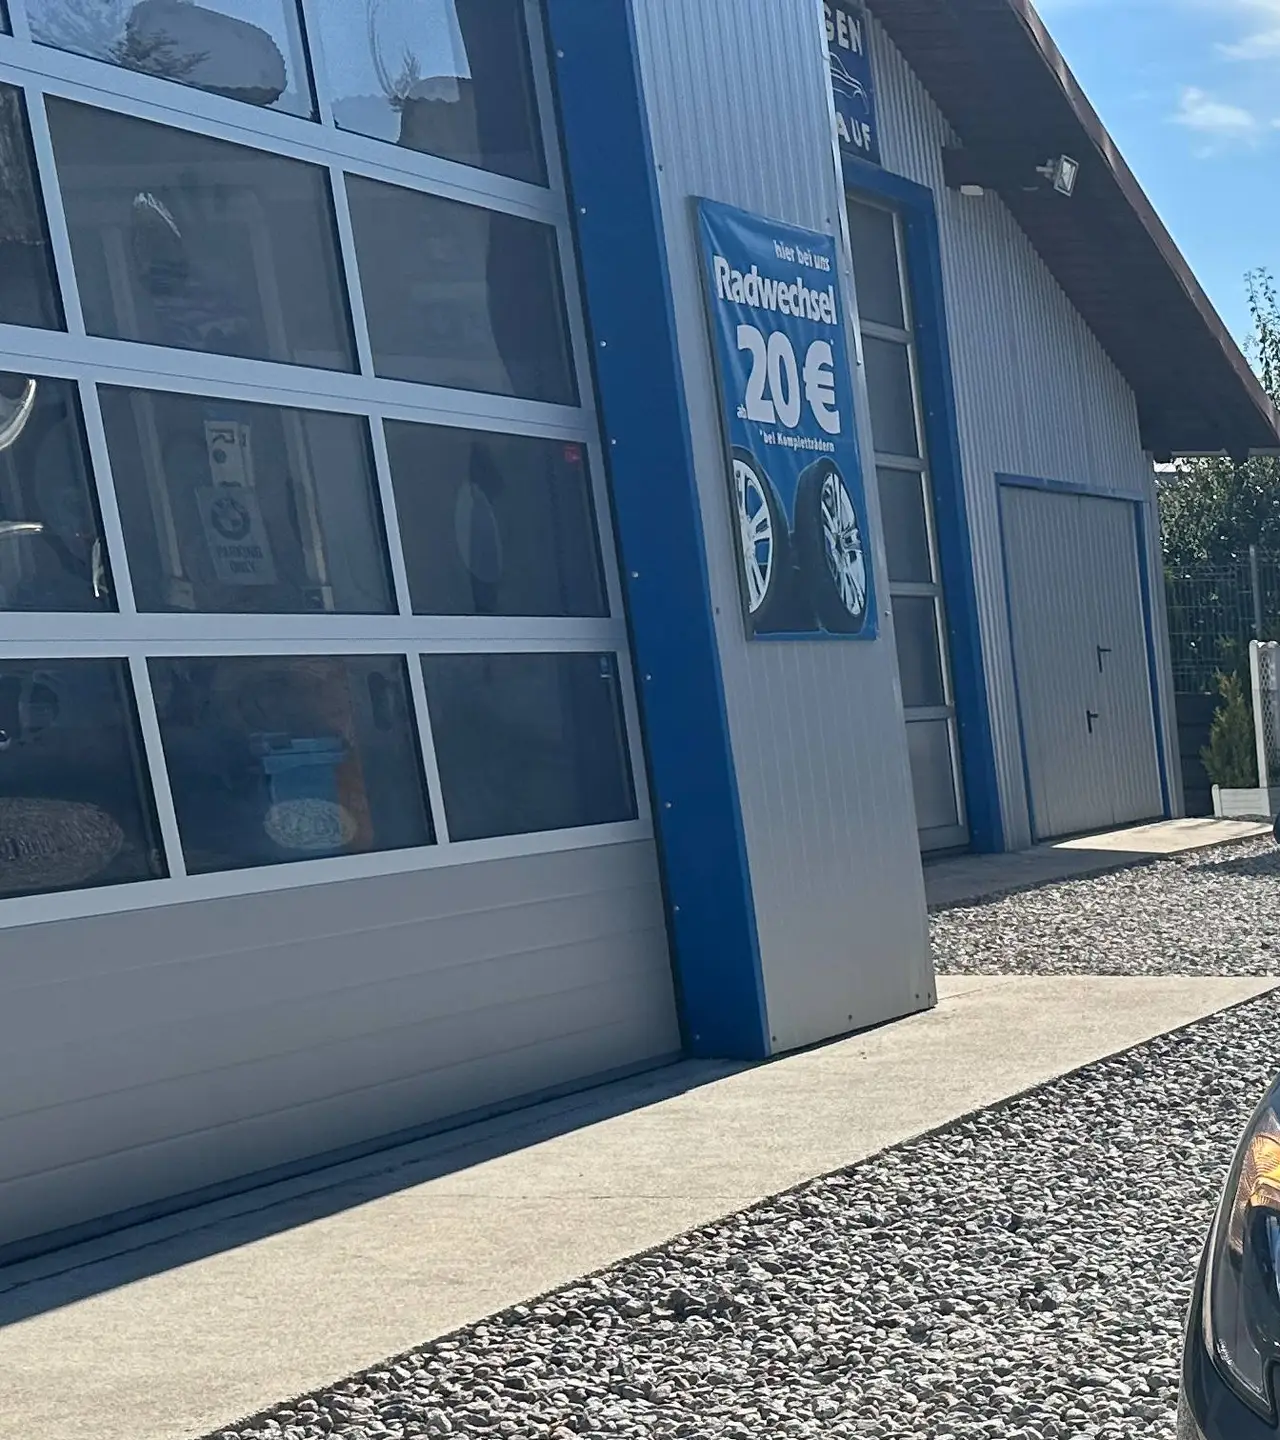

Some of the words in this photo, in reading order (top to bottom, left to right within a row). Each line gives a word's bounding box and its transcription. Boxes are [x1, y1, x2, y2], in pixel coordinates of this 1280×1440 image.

[773, 239, 795, 262] hier
[796, 245, 812, 267] bei
[814, 253, 831, 272] uns
[713, 255, 837, 325] Radwechsel
